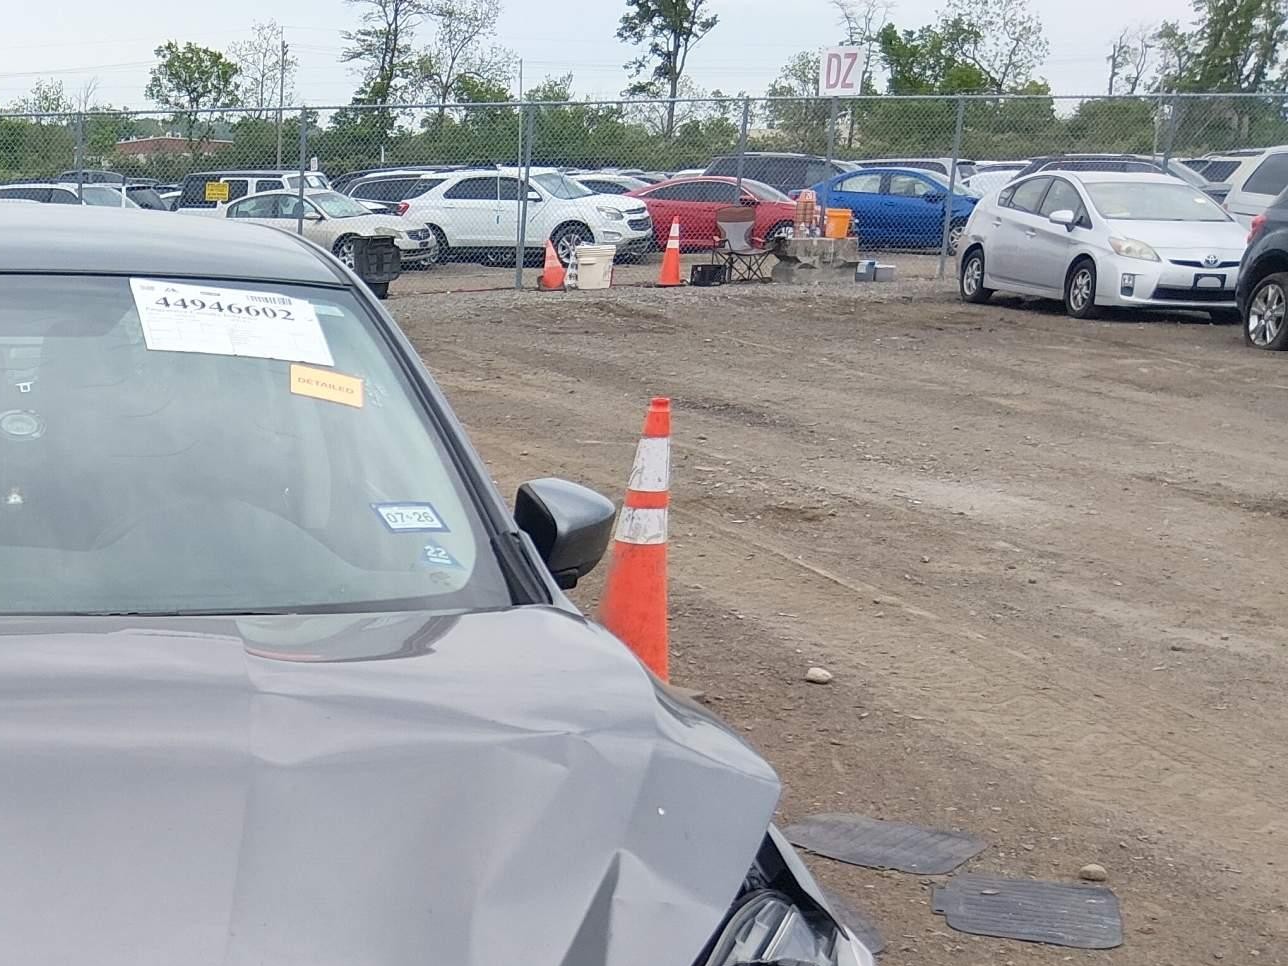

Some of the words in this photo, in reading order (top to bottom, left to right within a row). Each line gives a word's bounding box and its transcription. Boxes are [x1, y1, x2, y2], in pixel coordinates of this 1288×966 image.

[825, 52, 858, 89] DZ
[155, 296, 295, 322] 44946602
[297, 377, 355, 395] DETAILED
